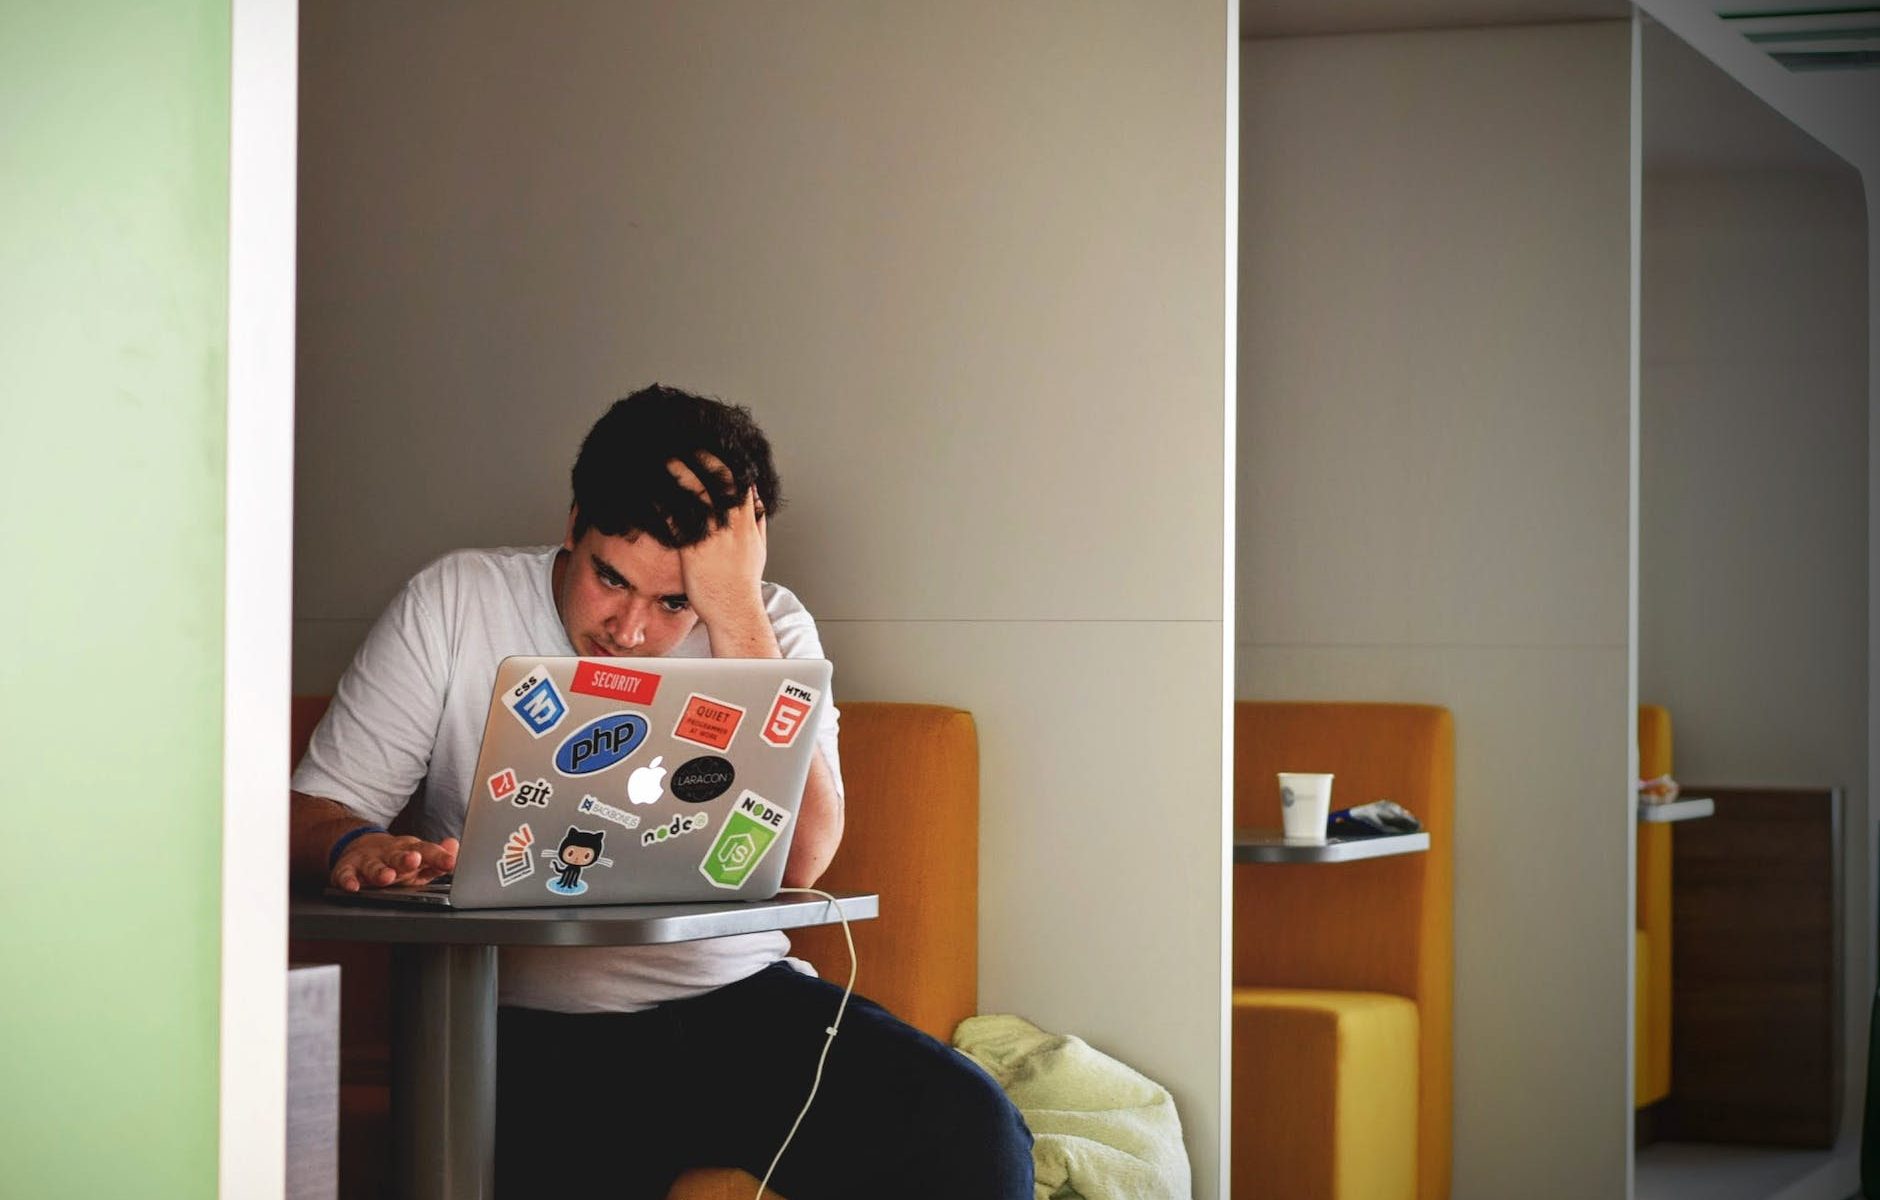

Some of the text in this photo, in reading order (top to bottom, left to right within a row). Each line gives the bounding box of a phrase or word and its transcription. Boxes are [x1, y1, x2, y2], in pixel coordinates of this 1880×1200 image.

[515, 676, 537, 697] CSS
[592, 671, 642, 693] SECURITY
[785, 685, 811, 702] HTML
[697, 706, 730, 723] QUIET
[771, 705, 801, 736] 5
[571, 723, 634, 771] php
[678, 773, 728, 786] LARACON
[515, 782, 550, 805] git
[742, 797, 783, 827] NODE
[718, 842, 748, 864] JS
